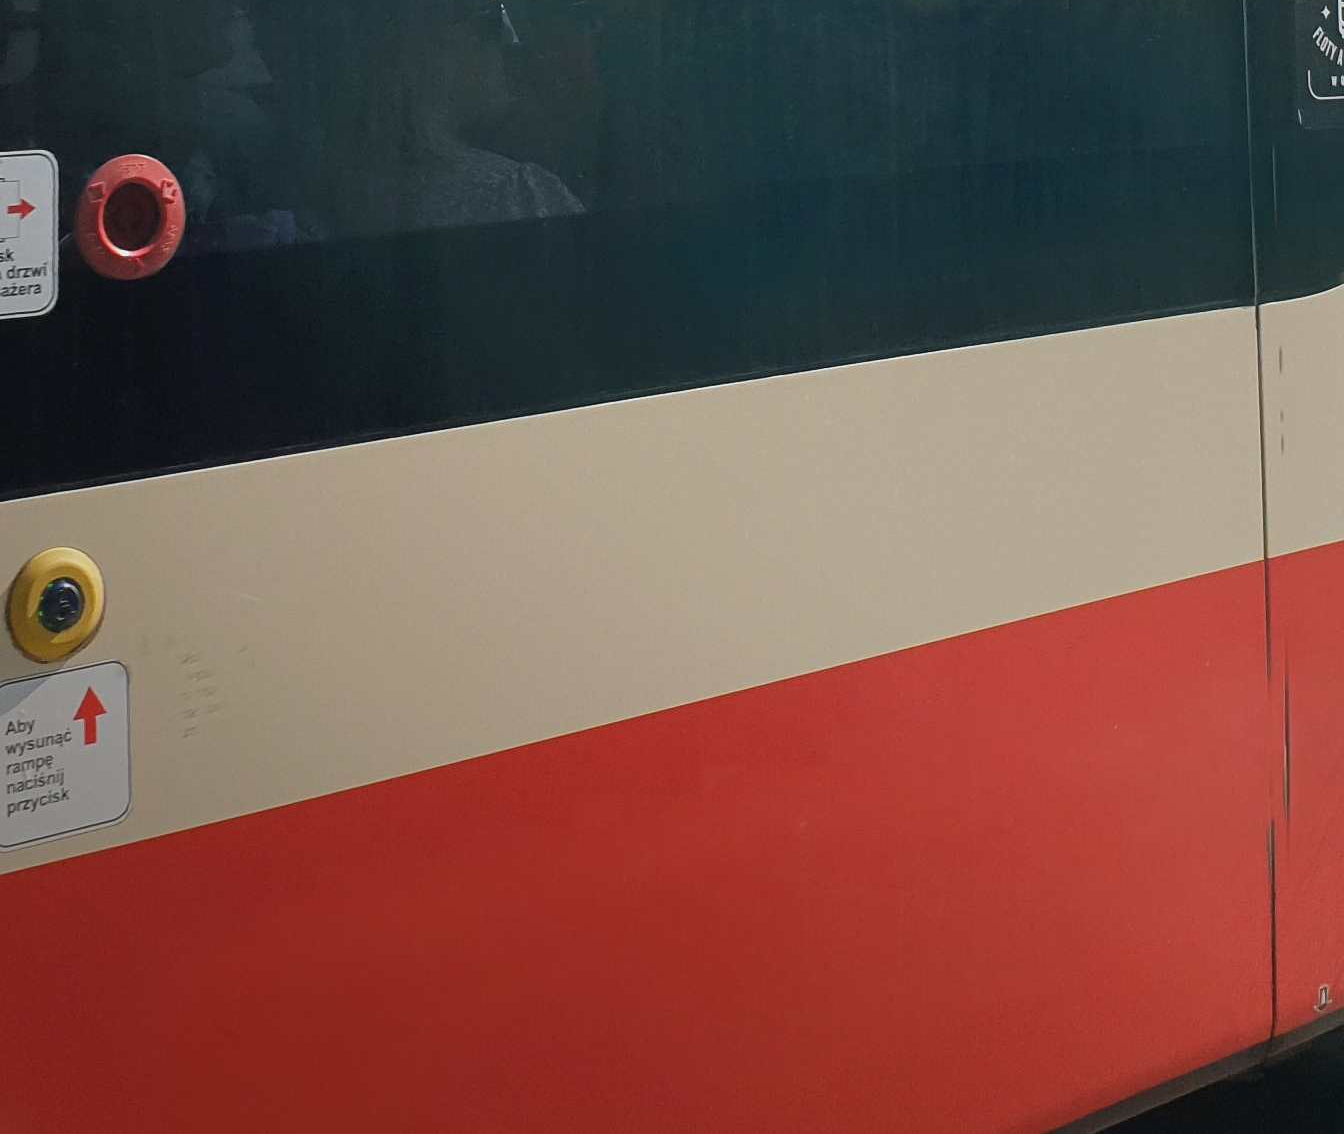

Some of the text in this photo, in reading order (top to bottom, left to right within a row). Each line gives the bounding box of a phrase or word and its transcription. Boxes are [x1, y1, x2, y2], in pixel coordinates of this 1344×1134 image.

[1312, 26, 1338, 61] FLOTY
[1331, 75, 1337, 86] W
[6, 262, 48, 279] drzwi
[6, 718, 36, 736] Aby
[5, 728, 73, 755] wysunąć
[5, 754, 54, 778] rampę
[6, 770, 65, 794] naciśnij
[6, 786, 71, 817] przycisk
